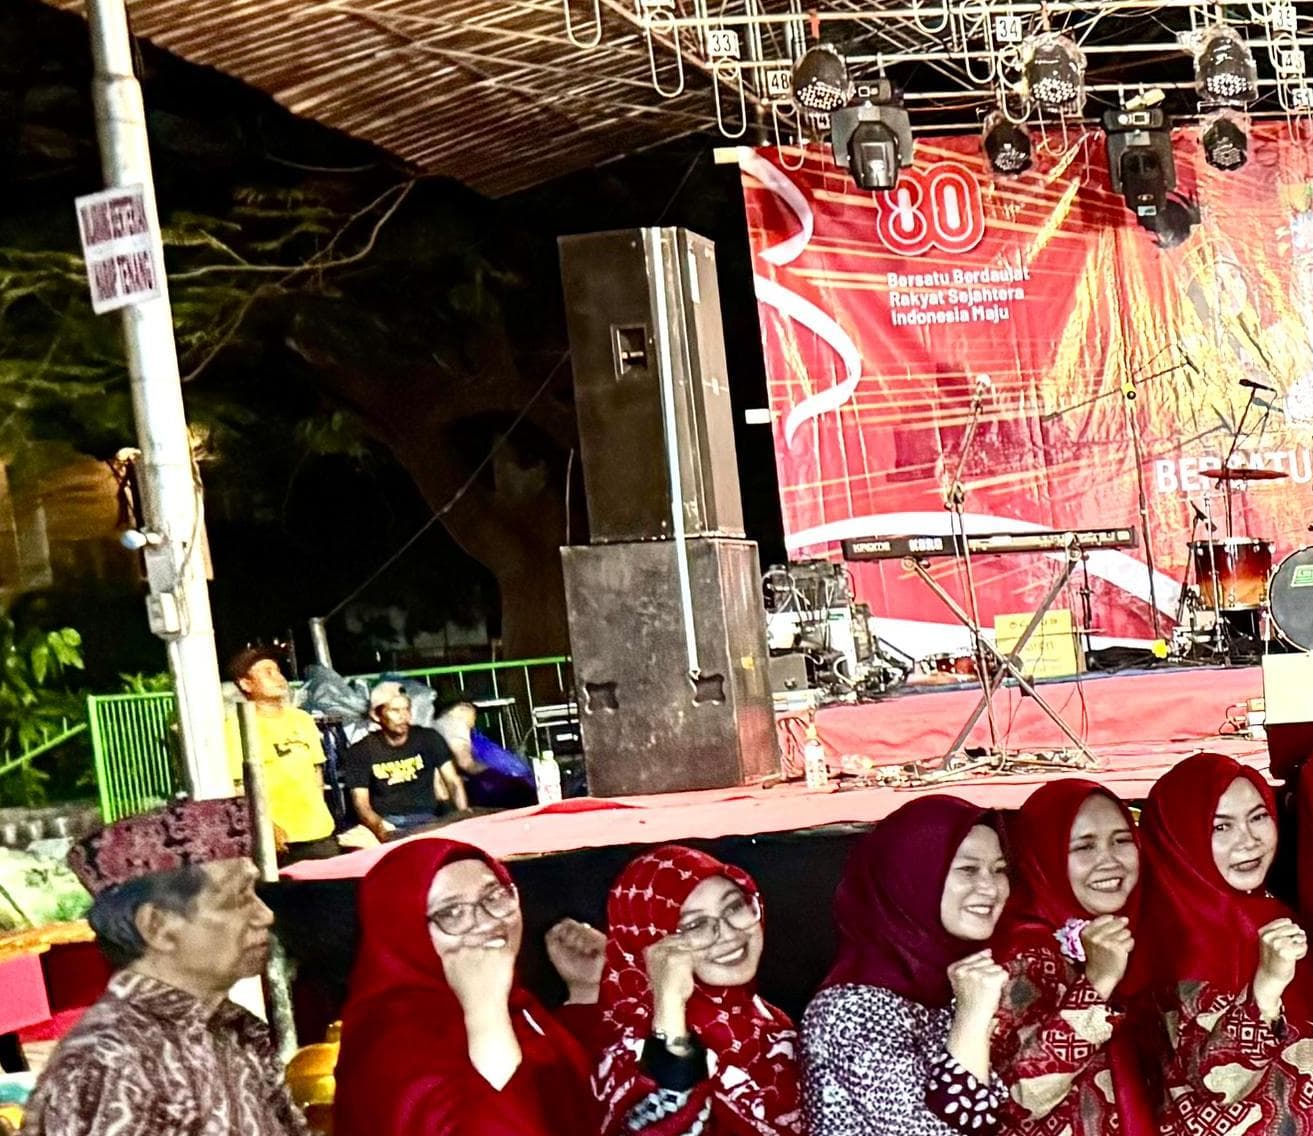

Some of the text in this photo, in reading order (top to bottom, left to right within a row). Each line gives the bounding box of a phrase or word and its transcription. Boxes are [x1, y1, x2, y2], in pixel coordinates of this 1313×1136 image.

[999, 19, 1018, 38] 34
[712, 33, 732, 52] 33
[771, 72, 790, 90] 48
[874, 162, 985, 257] 80
[887, 265, 1031, 288] Bersatu Berdaulat
[889, 286, 1025, 309] Rakyat Sejahtera
[891, 303, 1010, 326] Indonesia Maju
